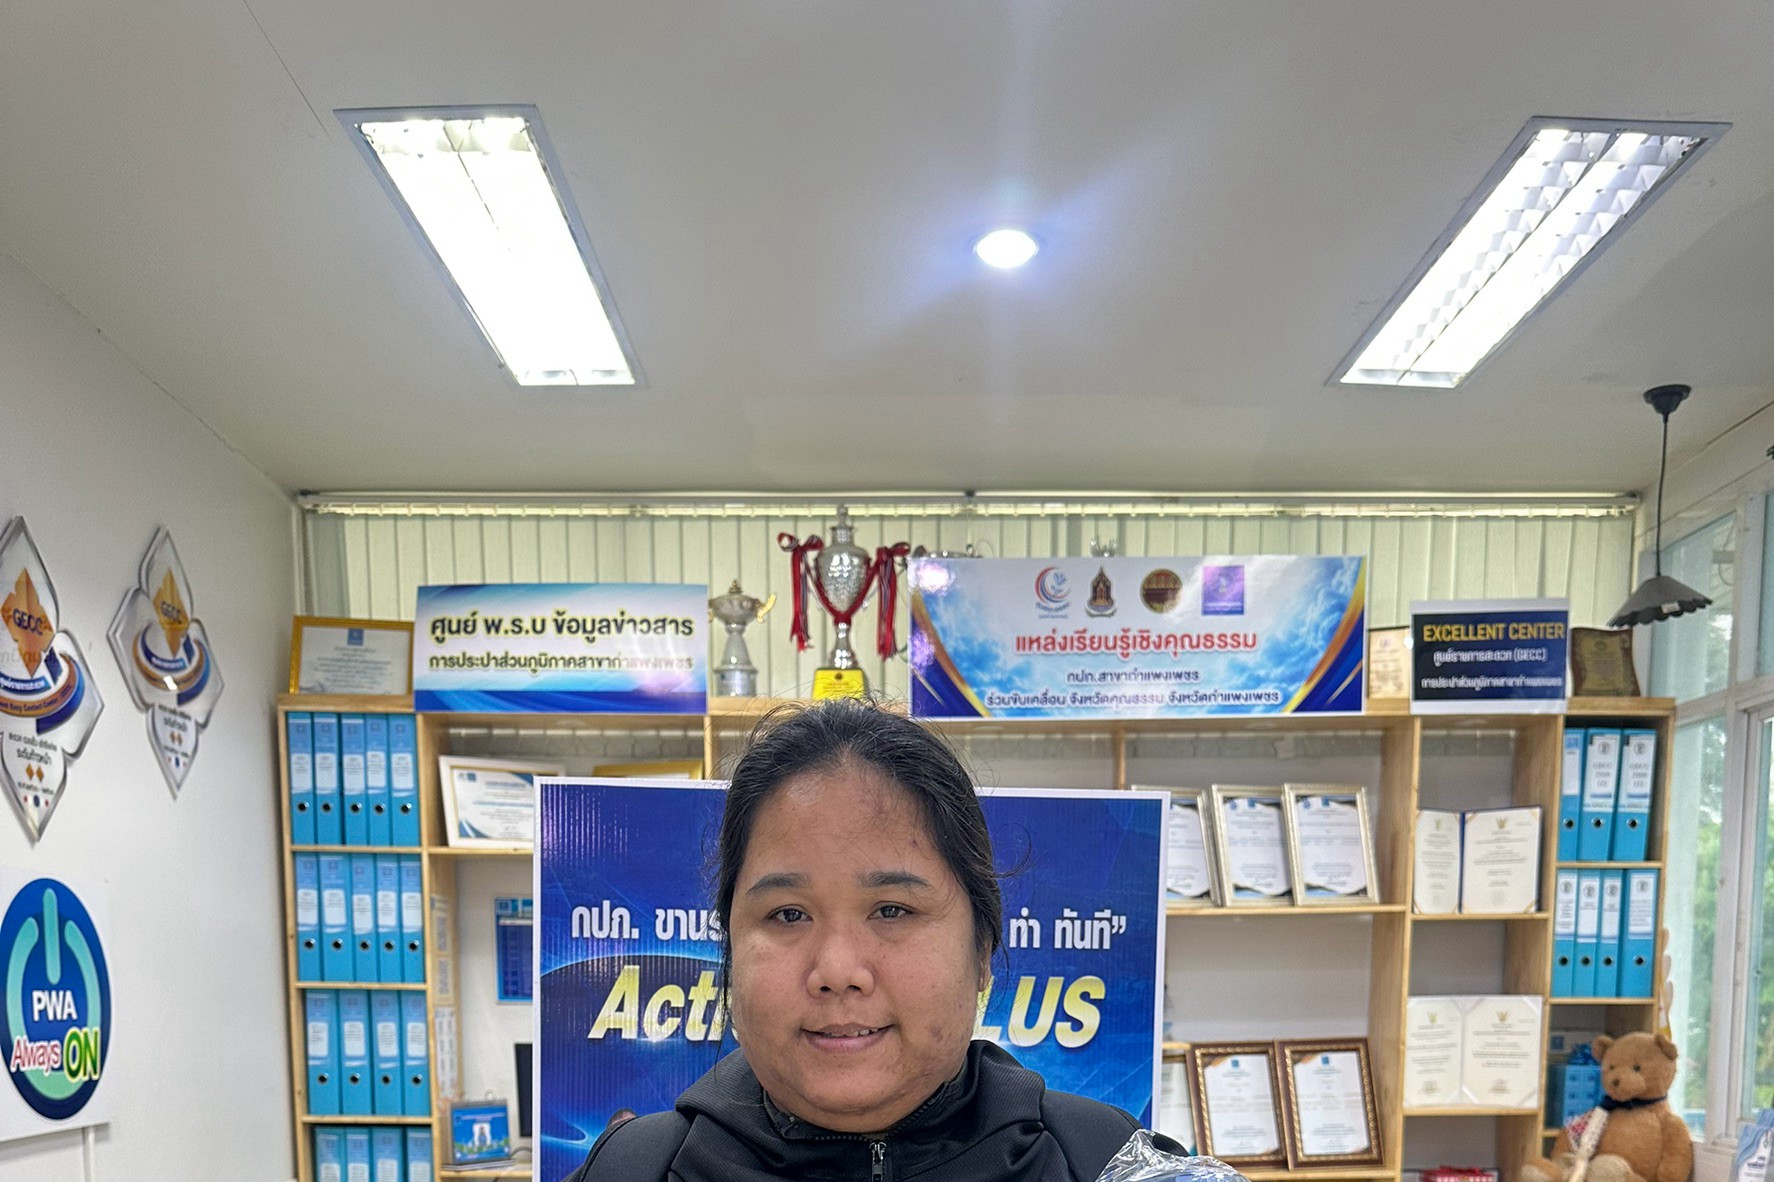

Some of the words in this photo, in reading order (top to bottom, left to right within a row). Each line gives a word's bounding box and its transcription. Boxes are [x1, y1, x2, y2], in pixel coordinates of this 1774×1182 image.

[13, 608, 43, 636] GECC
[431, 610, 478, 643] ศูนย์
[484, 617, 546, 635] พ.ร.บ
[554, 610, 693, 643] ข้อมูลข่าวสาร
[1422, 624, 1505, 642] EXCELLENT
[1509, 621, 1564, 640] CENTER
[1015, 628, 1257, 658] แหล่งเรียนรู้เชิงคุณธรรม
[571, 900, 639, 939] กปภ.
[655, 908, 723, 941] ขานร
[1009, 907, 1041, 948] ทำ
[31, 990, 78, 1021] PWA
[971, 975, 1106, 1048] LUS
[11, 1035, 61, 1074] Always
[63, 1026, 100, 1081] ON
